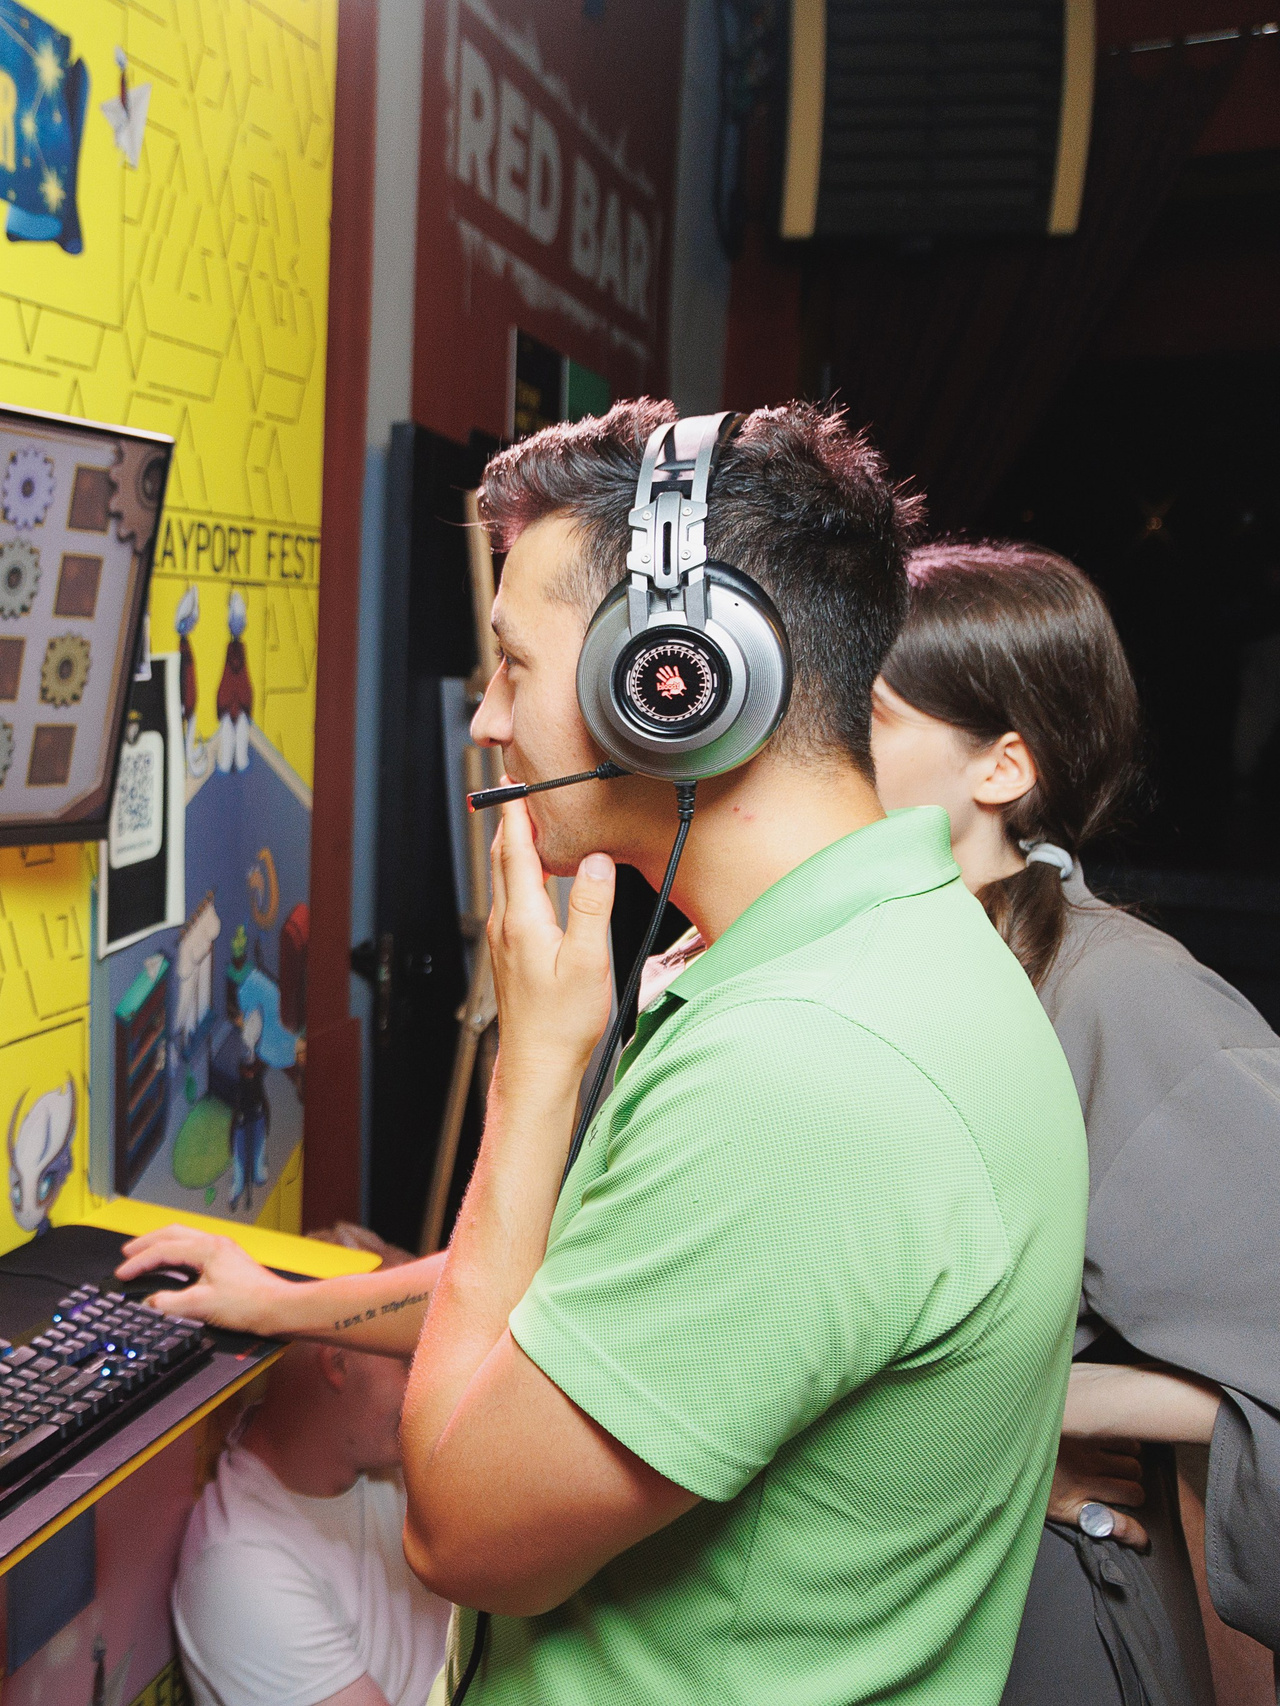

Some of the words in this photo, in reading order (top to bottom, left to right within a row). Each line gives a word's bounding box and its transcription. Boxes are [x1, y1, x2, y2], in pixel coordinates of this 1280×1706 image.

[456, 38, 563, 247] RED
[570, 158, 654, 322] BAR
[156, 517, 257, 573] AYPORT
[266, 532, 320, 580] FEST
